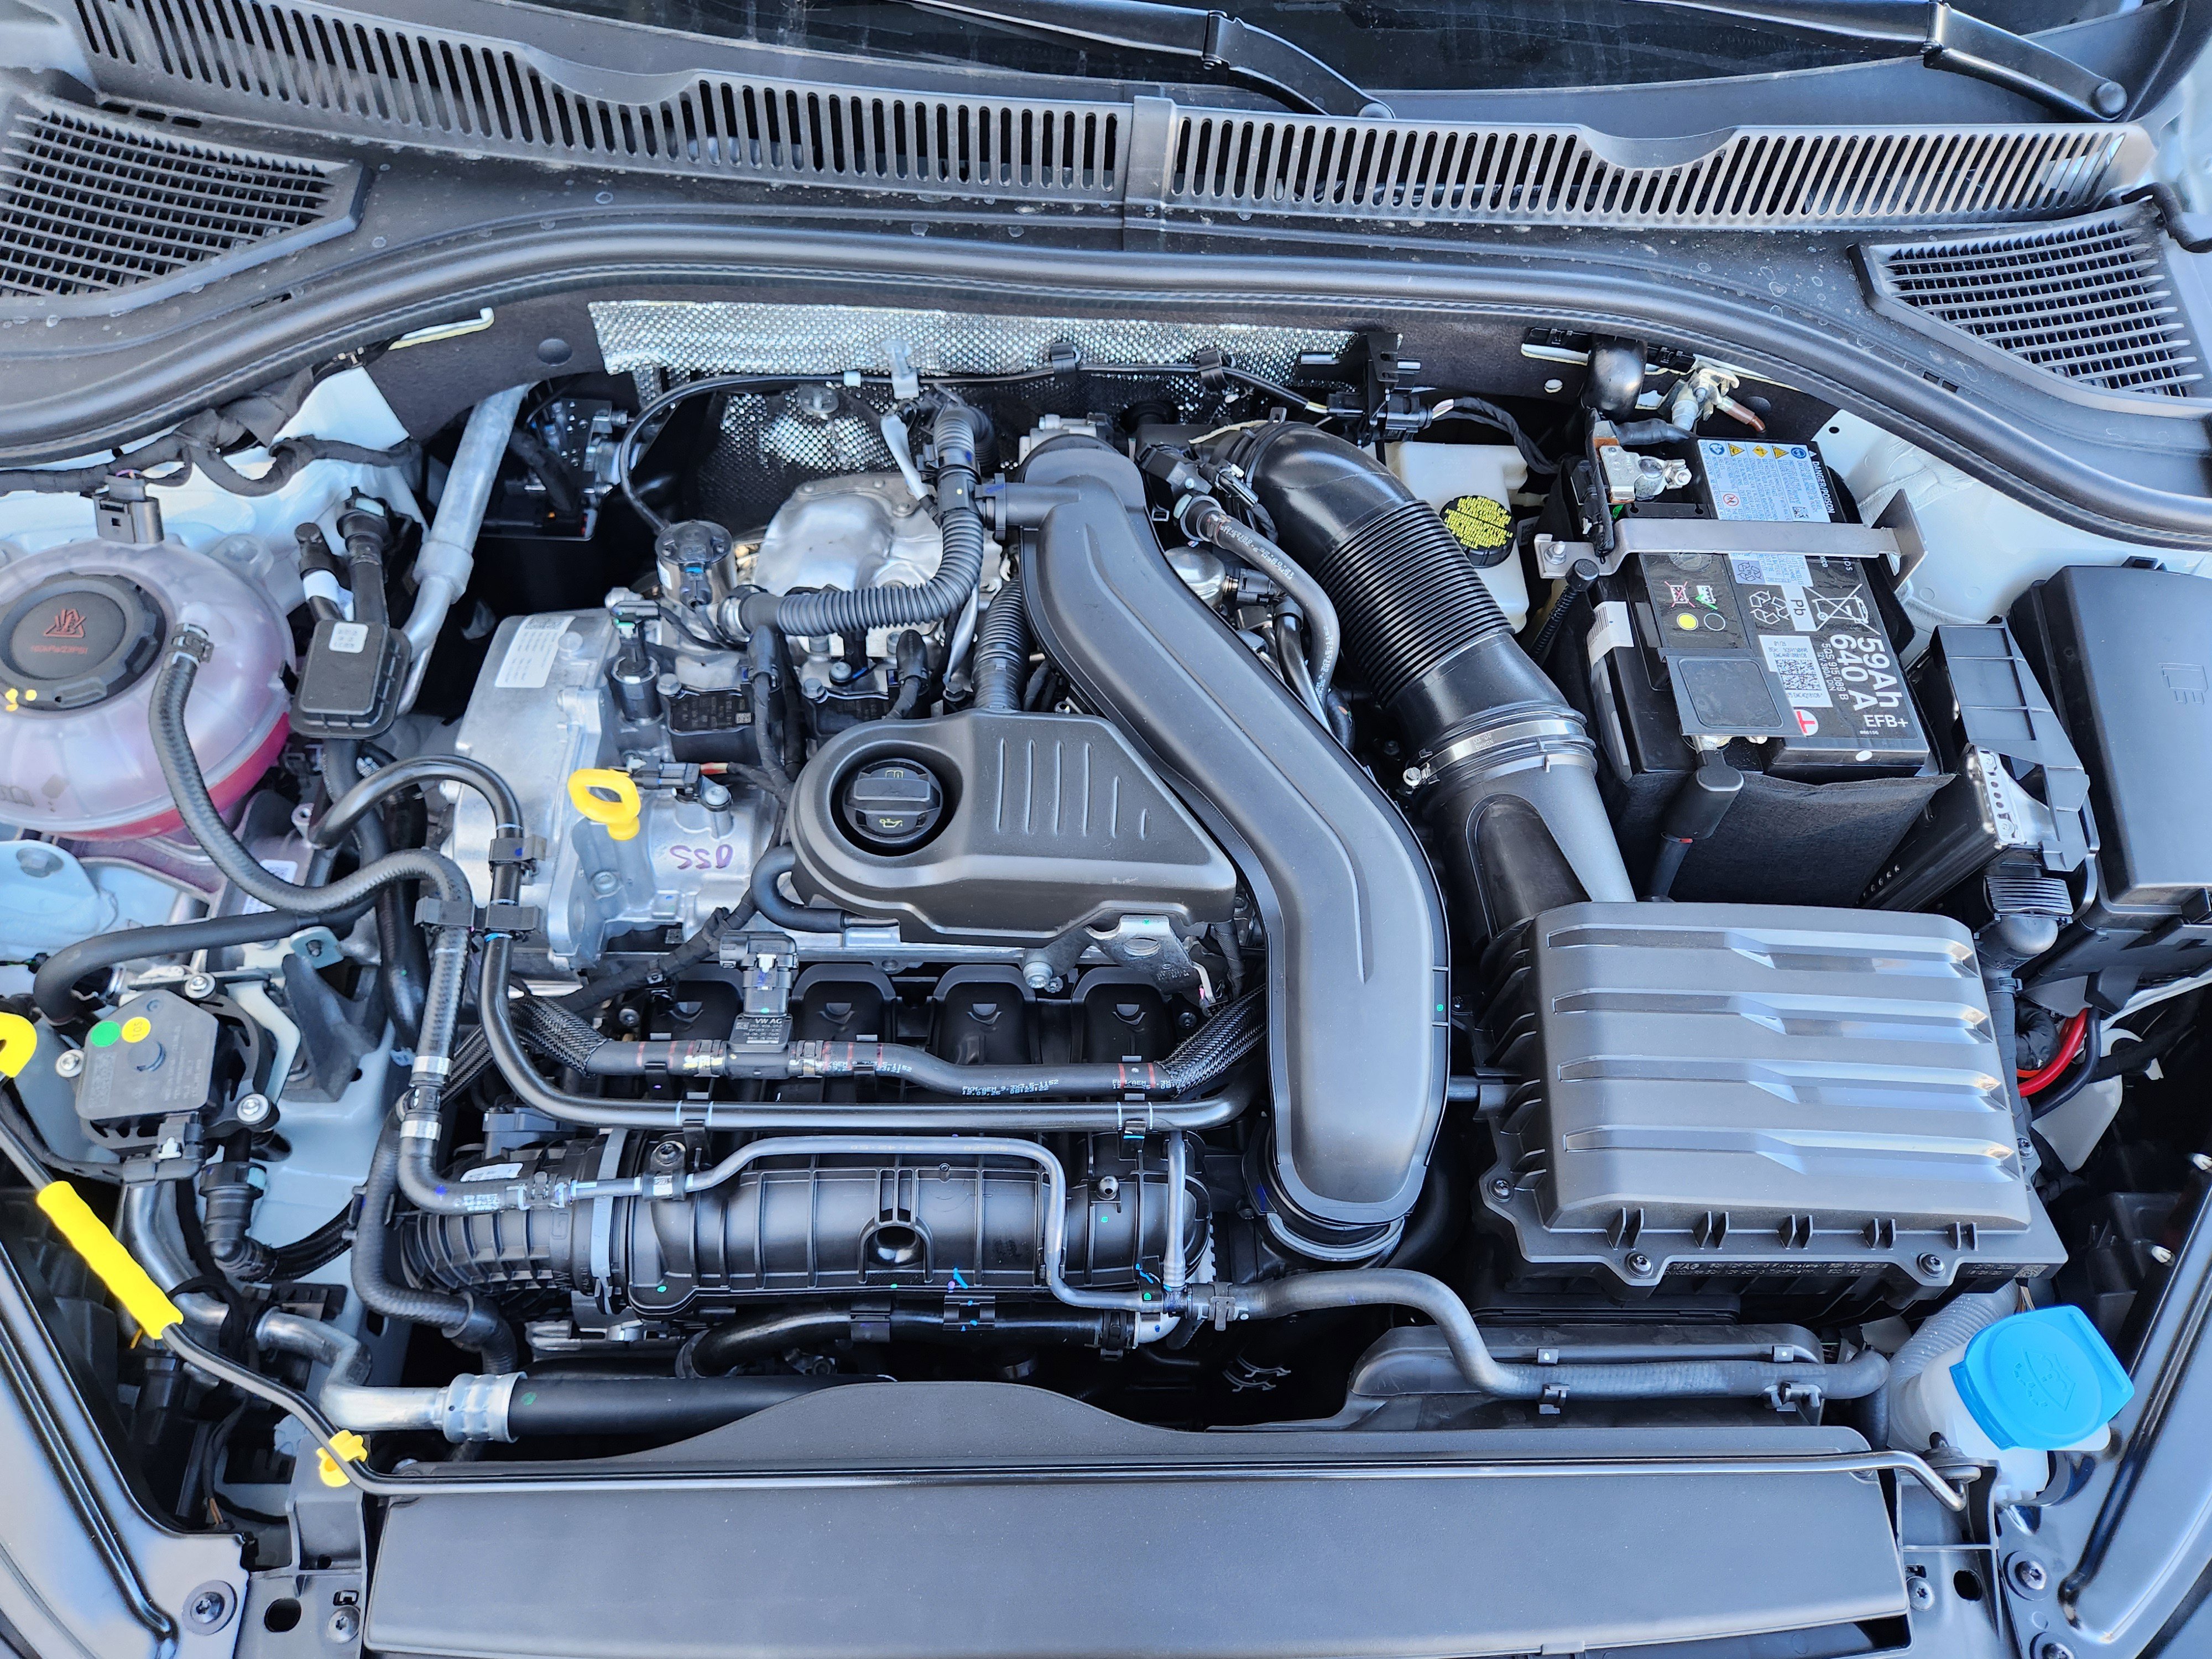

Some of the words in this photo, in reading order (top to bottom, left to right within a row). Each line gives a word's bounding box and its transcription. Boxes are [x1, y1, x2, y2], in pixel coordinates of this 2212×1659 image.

[1811, 461, 1835, 513] DANGER/POISON
[1791, 599, 1804, 617] Pb
[1828, 661, 1840, 675] 915
[1830, 634, 1869, 682] 640
[1817, 652, 1827, 662] 12V
[1826, 680, 1837, 691] DIN
[1857, 637, 1903, 707] 59Ah
[1833, 677, 1846, 692] 089
[1848, 690, 1879, 711] A
[1863, 714, 1908, 728] EFB+
